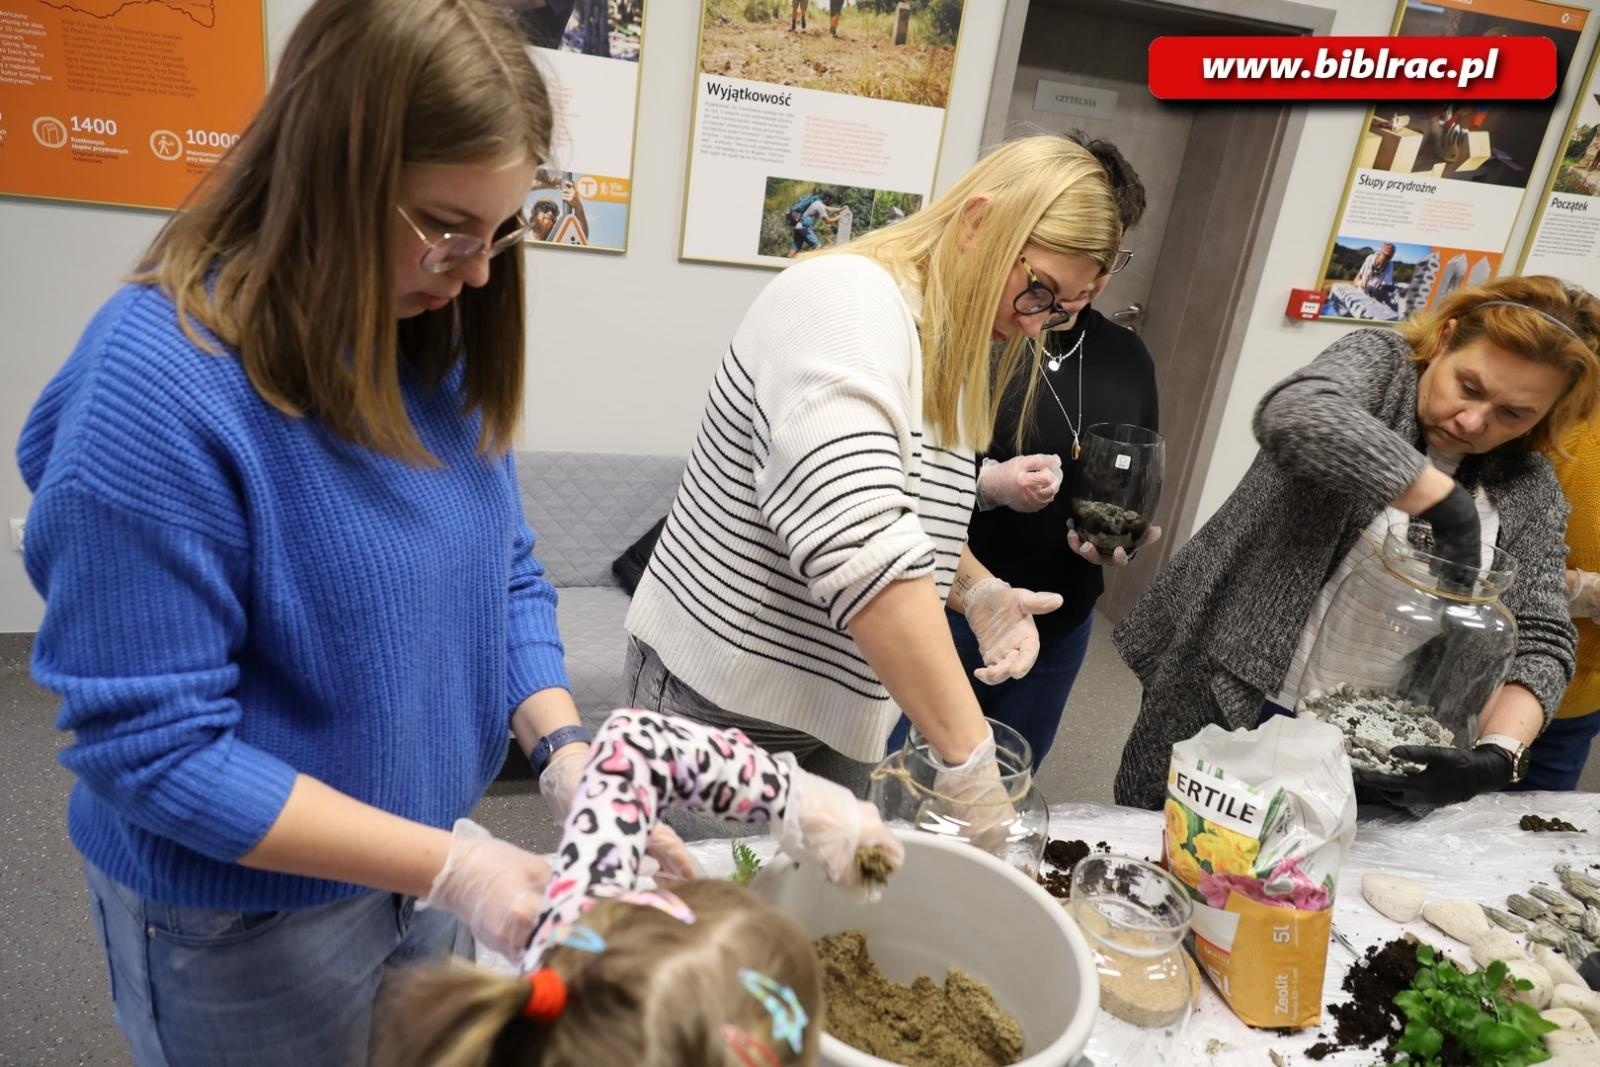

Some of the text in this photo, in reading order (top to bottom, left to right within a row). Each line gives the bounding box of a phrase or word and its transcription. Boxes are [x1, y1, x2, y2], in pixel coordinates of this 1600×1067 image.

[707, 81, 792, 107] Wyjątkowość
[1055, 94, 1097, 108] CZYTELNIA
[70, 115, 118, 136] 1400
[1358, 174, 1437, 194] Słupy przydrożne
[1550, 197, 1589, 213] Początek
[1274, 973, 1289, 1015] Zeolit
